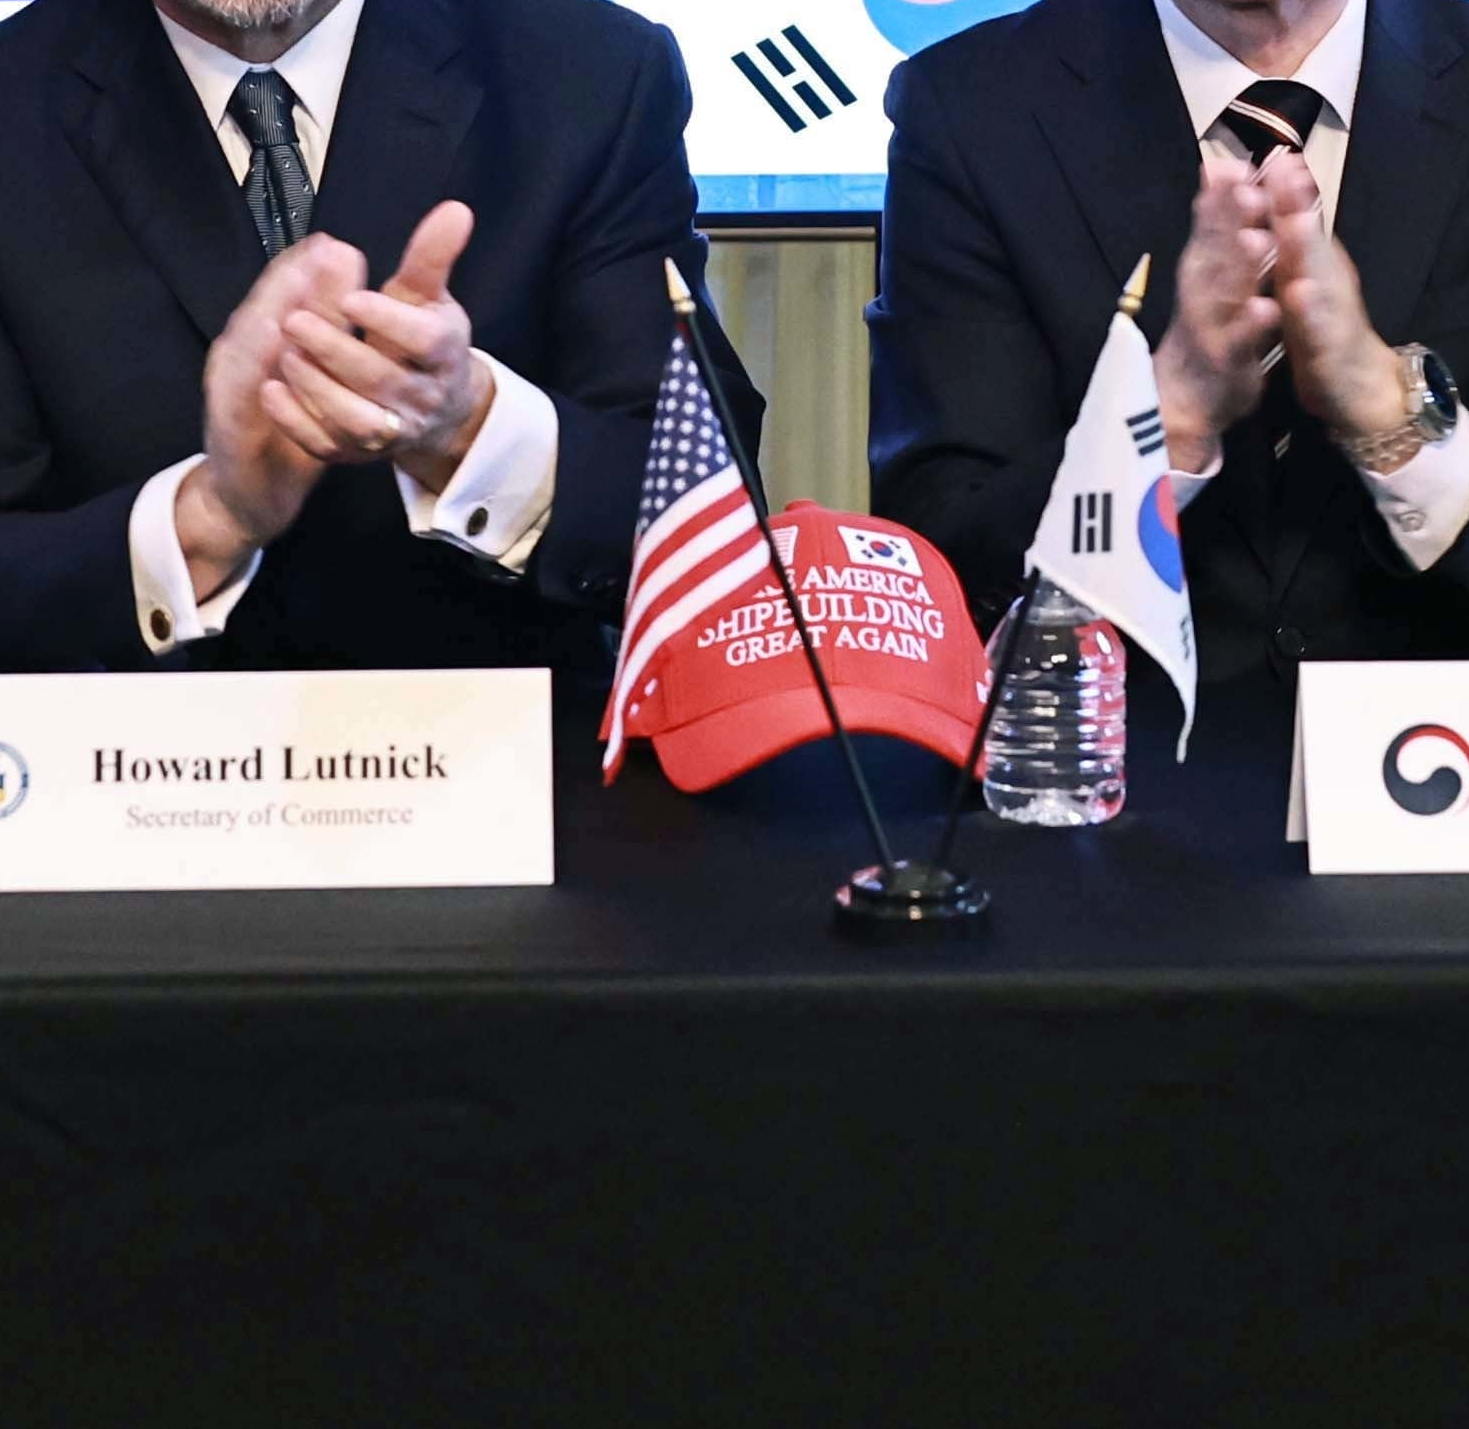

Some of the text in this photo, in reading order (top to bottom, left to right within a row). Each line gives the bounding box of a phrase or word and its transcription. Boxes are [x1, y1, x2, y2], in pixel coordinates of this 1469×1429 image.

[801, 564, 935, 605] AMERICA
[725, 624, 930, 666] GREAT AGAIN
[92, 745, 449, 784] Howard Lutnick
[126, 802, 413, 831] Secretary of Commerce
